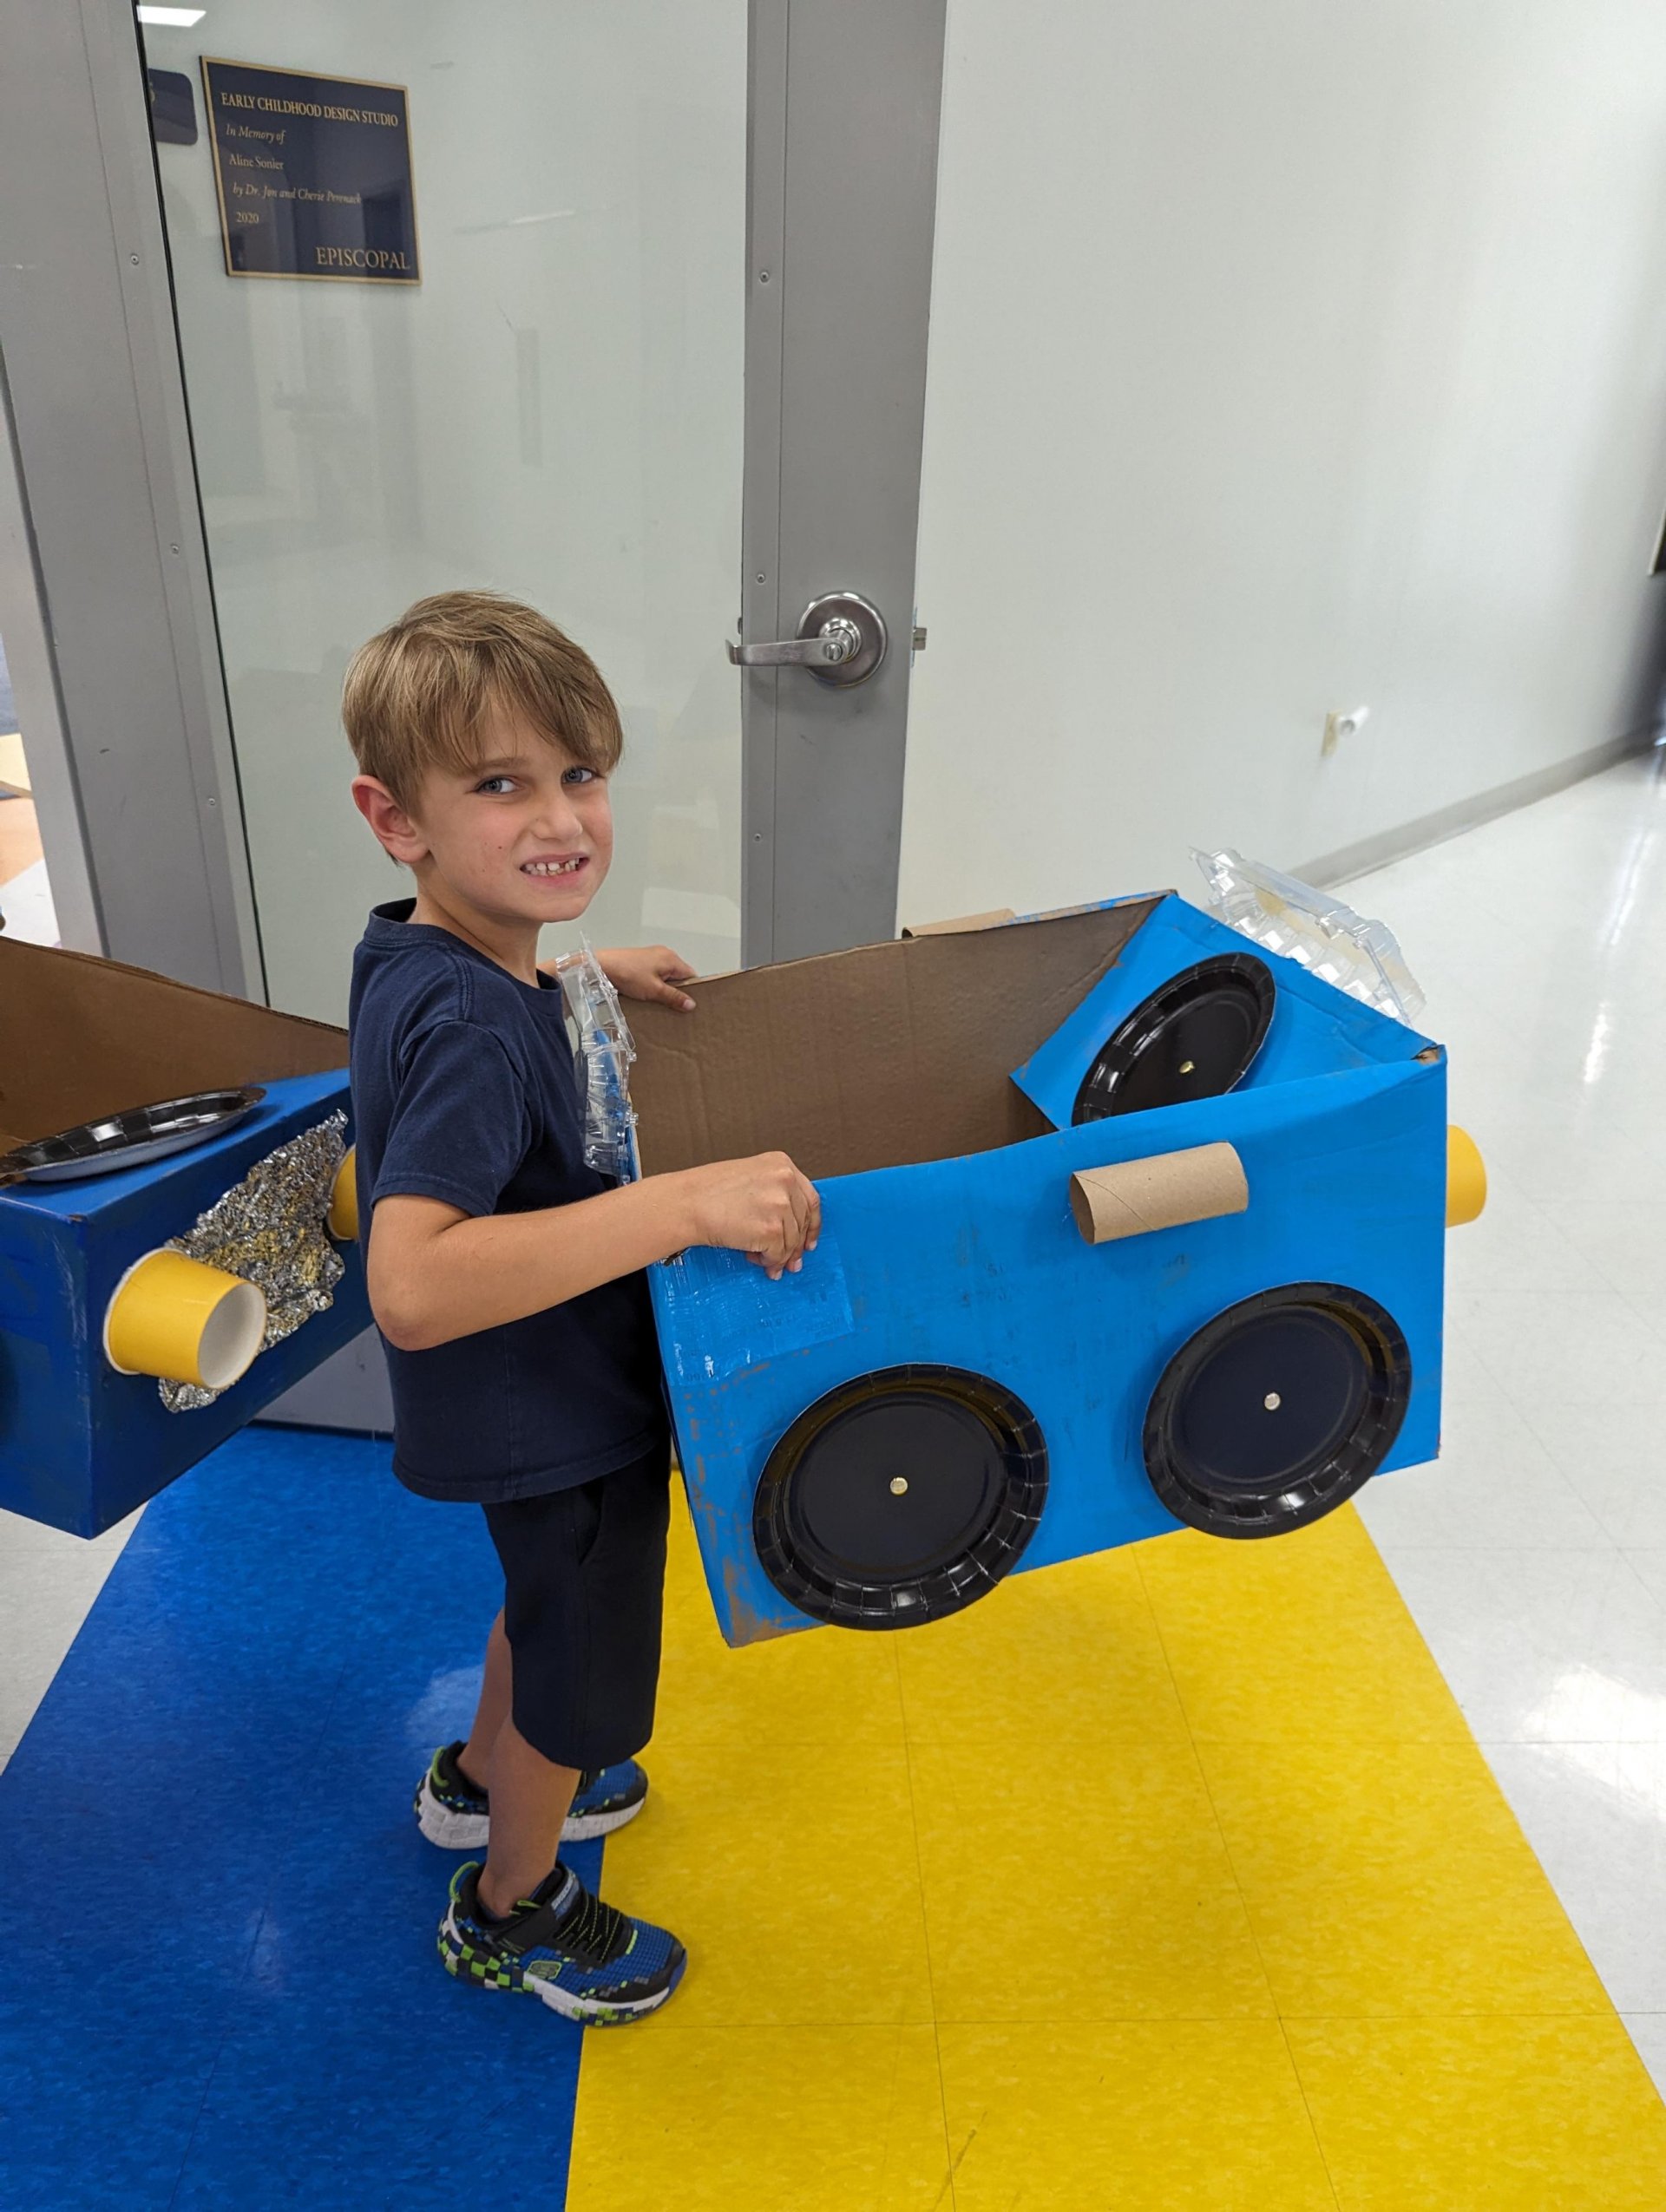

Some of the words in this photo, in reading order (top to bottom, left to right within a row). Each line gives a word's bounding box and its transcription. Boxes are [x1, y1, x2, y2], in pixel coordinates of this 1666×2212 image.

[220, 92, 256, 109] EARLY
[257, 96, 323, 118] CHILDHOOD
[324, 107, 361, 123] DESIGN
[361, 110, 399, 128] STUDIO
[225, 123, 237, 137] In
[238, 126, 275, 143] Memory
[276, 129, 287, 146] of
[228, 153, 254, 167] Aline
[233, 181, 243, 198] by
[245, 184, 261, 197] Dr.
[279, 187, 297, 200] and
[235, 212, 259, 225] 2020
[315, 246, 411, 271] EPISCOPAL
